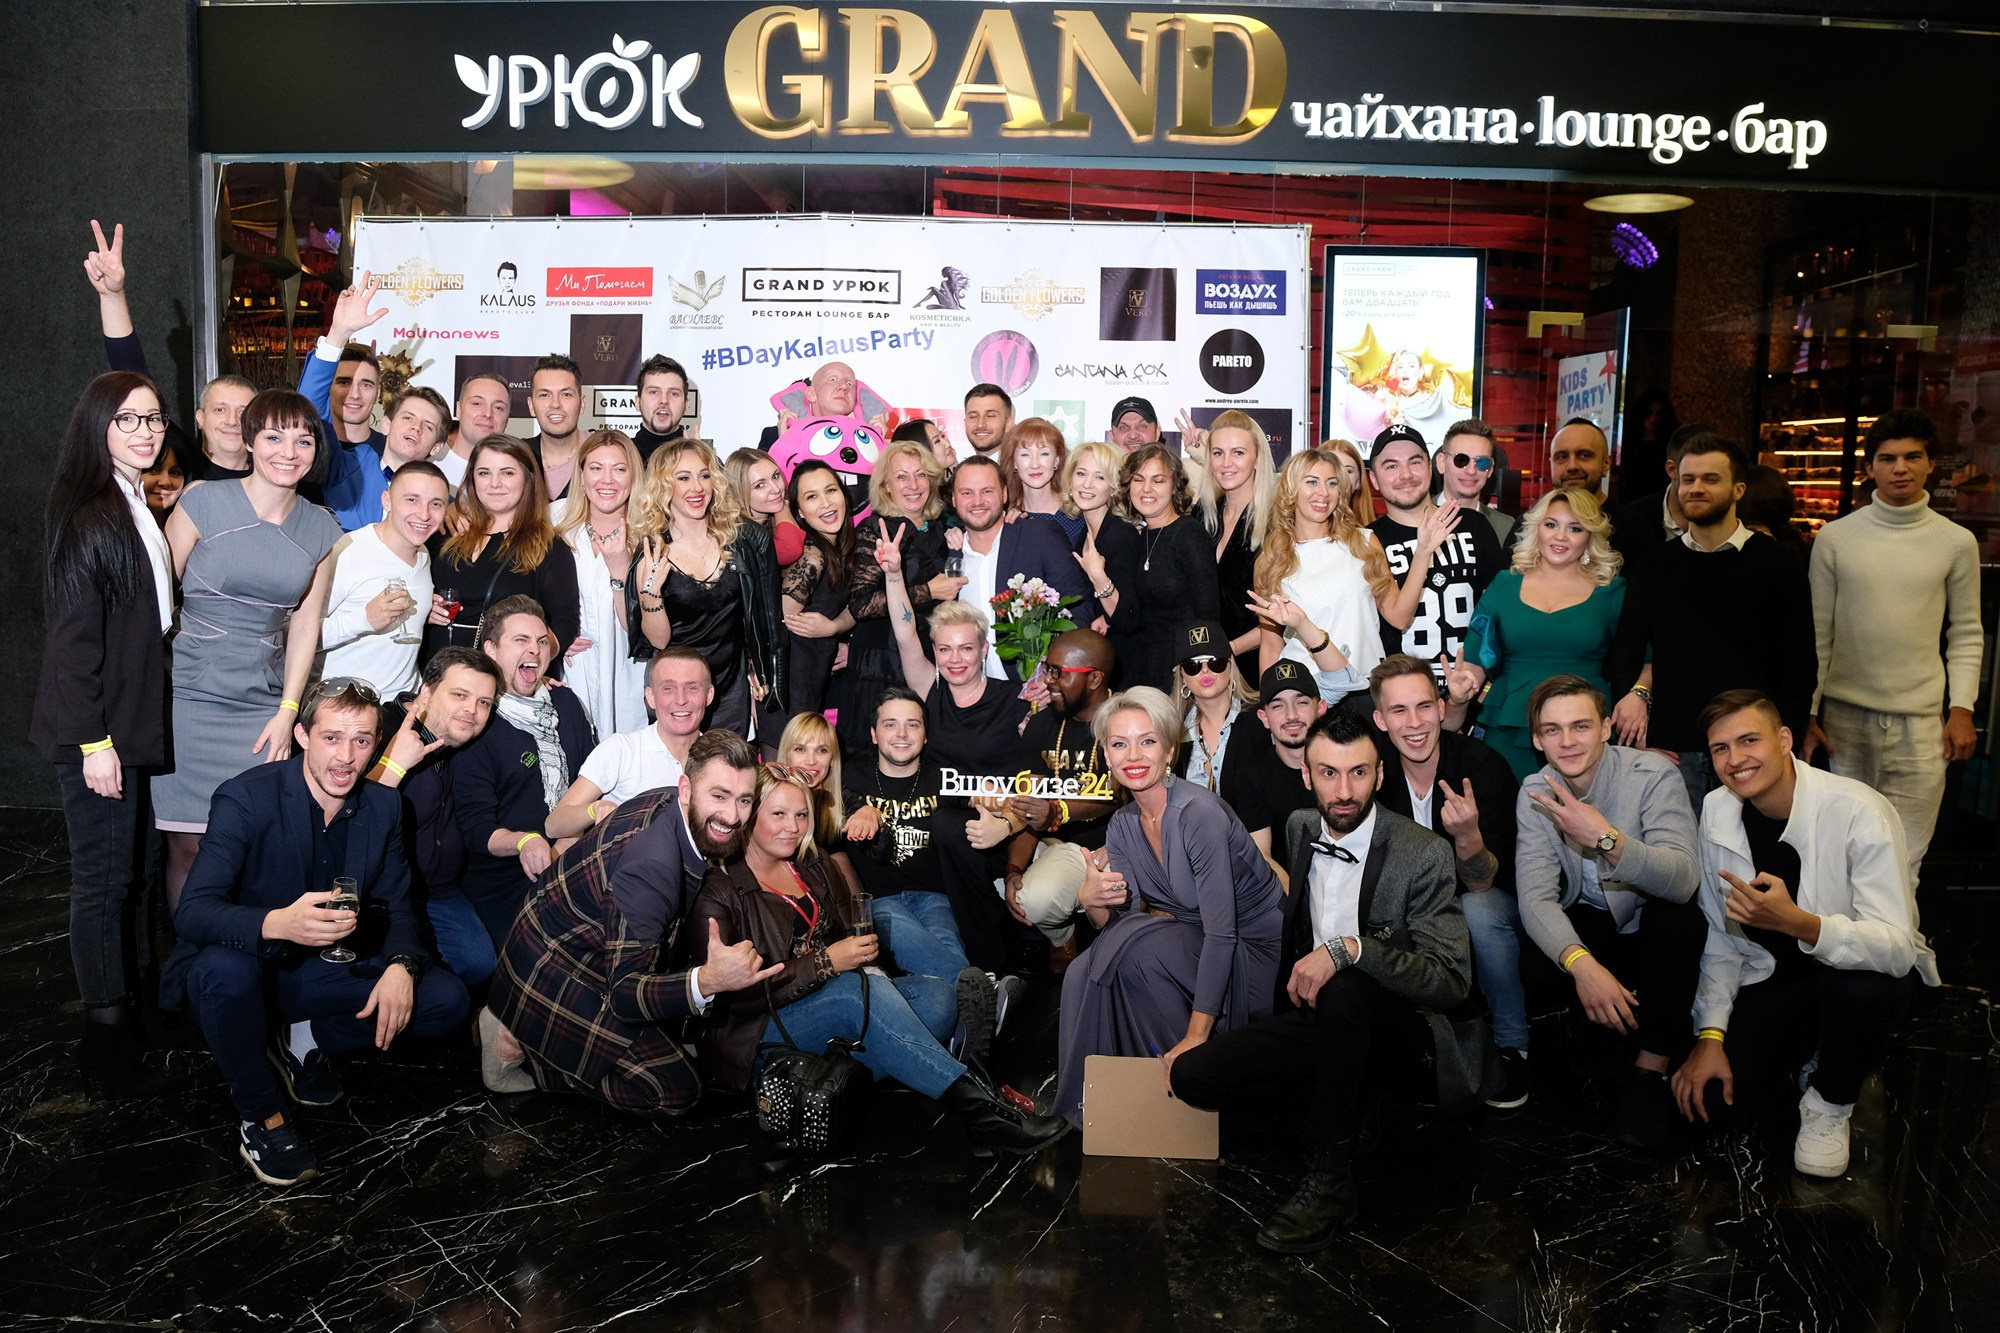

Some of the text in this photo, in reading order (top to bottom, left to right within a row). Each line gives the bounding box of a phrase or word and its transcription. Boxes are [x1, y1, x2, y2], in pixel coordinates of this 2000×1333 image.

[723, 5, 1287, 144] GRAND
[455, 33, 703, 131] УРЮК
[412, 275, 463, 289] FLOWERS
[555, 273, 646, 292] Мы Помогаем
[753, 279, 890, 293] GRAND УРЮК
[983, 287, 1084, 304] GOLDEN FLOWERS
[1204, 283, 1277, 300] ВОЗДУХ
[1343, 288, 1451, 298] ТЕПЕРЬ КАЖДЫЙ ГОД
[480, 294, 536, 307] KALAUS
[1204, 301, 1278, 310] ПЬЕШЬ КАК ДЫШИШЬ
[867, 311, 890, 319] БАР
[909, 314, 972, 322] KOSMETICHKA
[1125, 307, 1152, 317] VERO
[393, 326, 500, 339] Malinanews
[701, 328, 935, 370] #BDayKalausParty
[593, 353, 619, 362] VERO
[1212, 354, 1252, 368] PARETO
[1559, 367, 1588, 395] KIDS
[600, 398, 637, 408] GRAN
[1567, 382, 1607, 415] PARTY
[1401, 582, 1475, 660] 89
[940, 768, 1114, 801] Вшоубизе24
